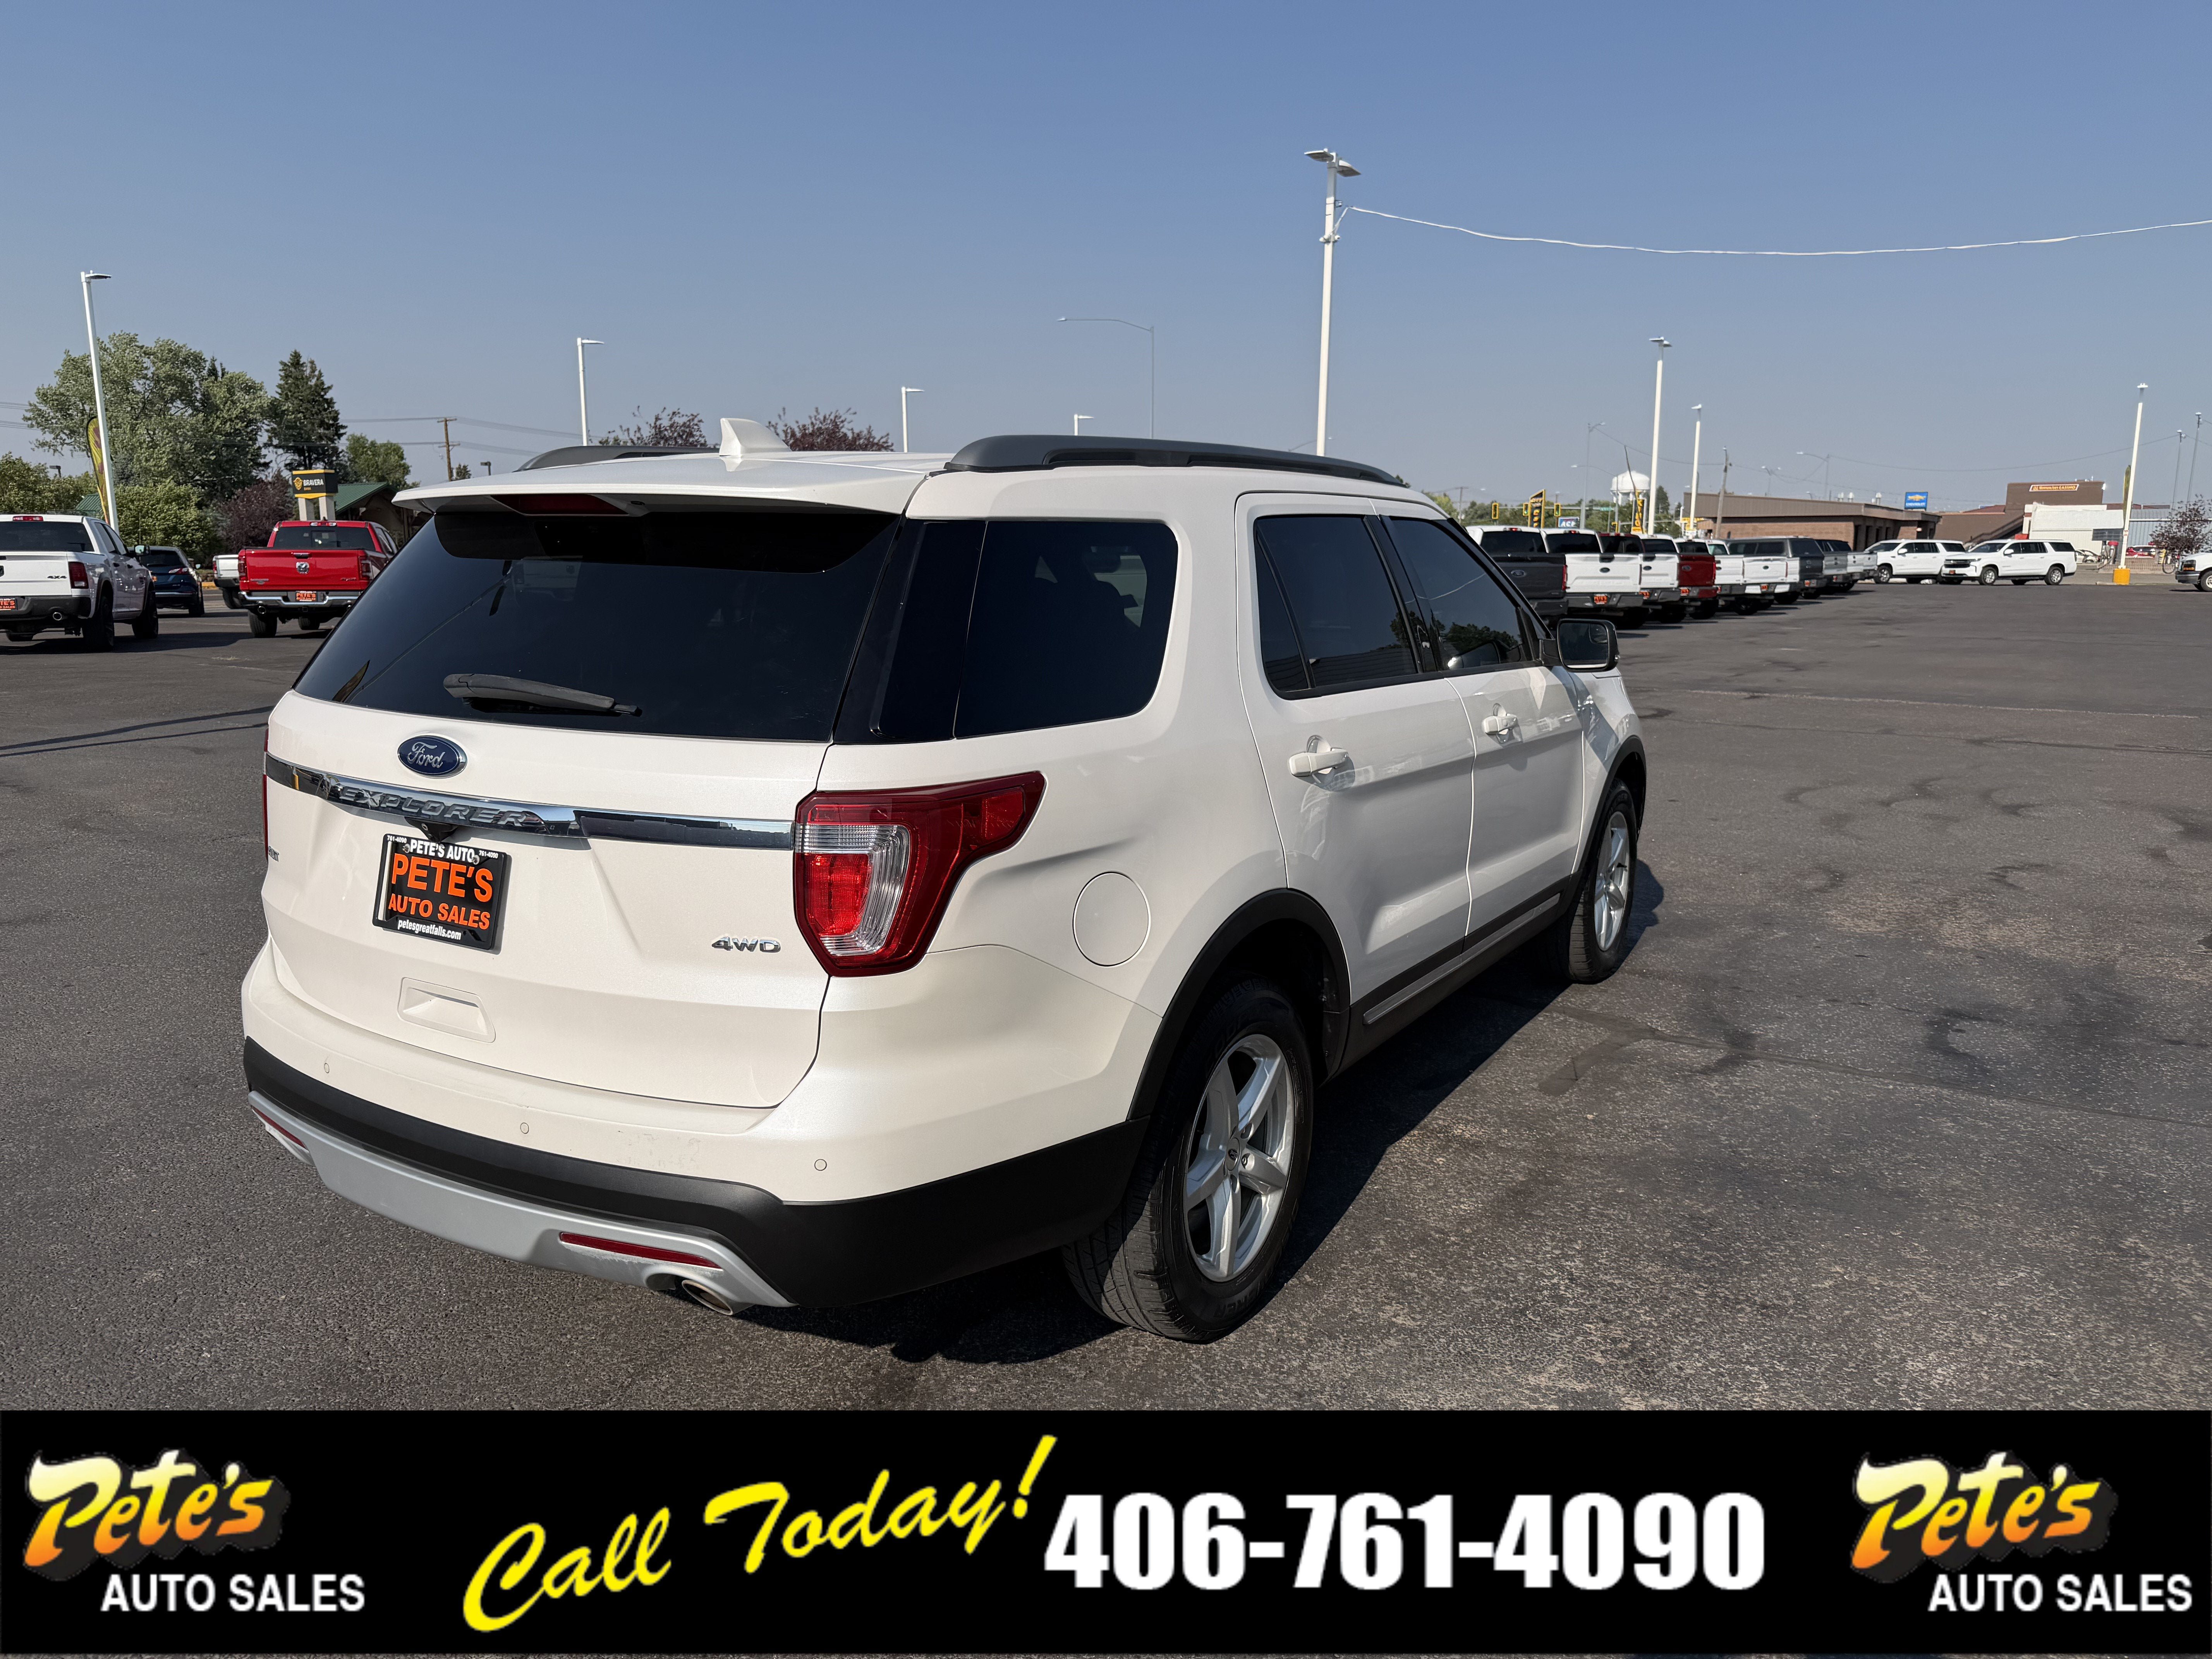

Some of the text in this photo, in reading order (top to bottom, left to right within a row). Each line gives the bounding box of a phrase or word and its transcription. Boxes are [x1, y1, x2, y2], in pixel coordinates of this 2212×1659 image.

[408, 742, 445, 768] Ford
[339, 787, 528, 827] EXPLORER
[387, 835, 498, 862] 761-4090 PETE'S AUTO 761-4090
[392, 853, 493, 902] PETE'S
[388, 893, 490, 930] AUTO SALES
[398, 919, 461, 940] petesgreatfalls.com
[712, 936, 781, 953] 4WD
